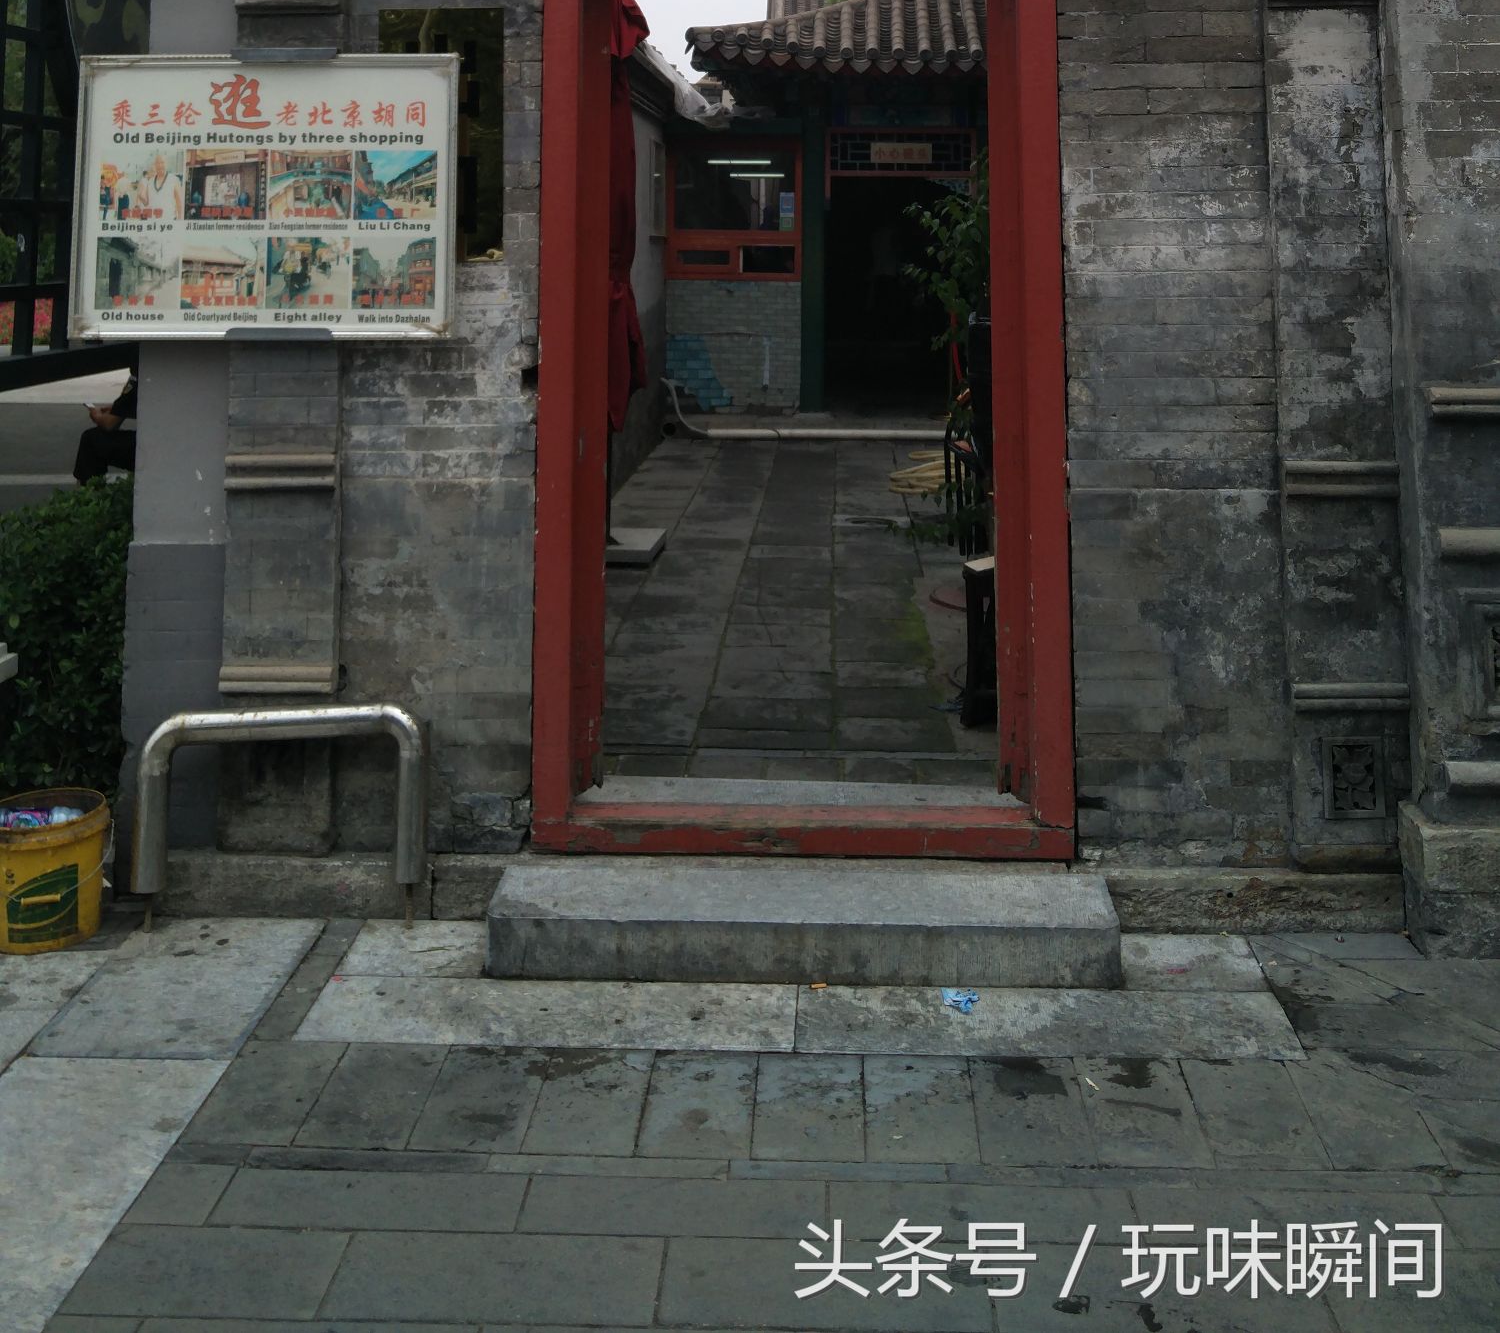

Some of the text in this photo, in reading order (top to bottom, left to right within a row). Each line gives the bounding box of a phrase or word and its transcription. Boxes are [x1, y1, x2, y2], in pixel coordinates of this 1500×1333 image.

[113, 132, 424, 146] Old Beijing Hutongs by three shopping
[101, 222, 173, 232] Beijing si ye
[358, 221, 431, 232] Liu Li Chang
[101, 311, 165, 321] Old house
[196, 312, 232, 323] Courtyard
[233, 312, 258, 323] Beijing
[274, 312, 342, 323] Eight alley
[357, 314, 377, 323] Walk
[378, 313, 394, 323] into
